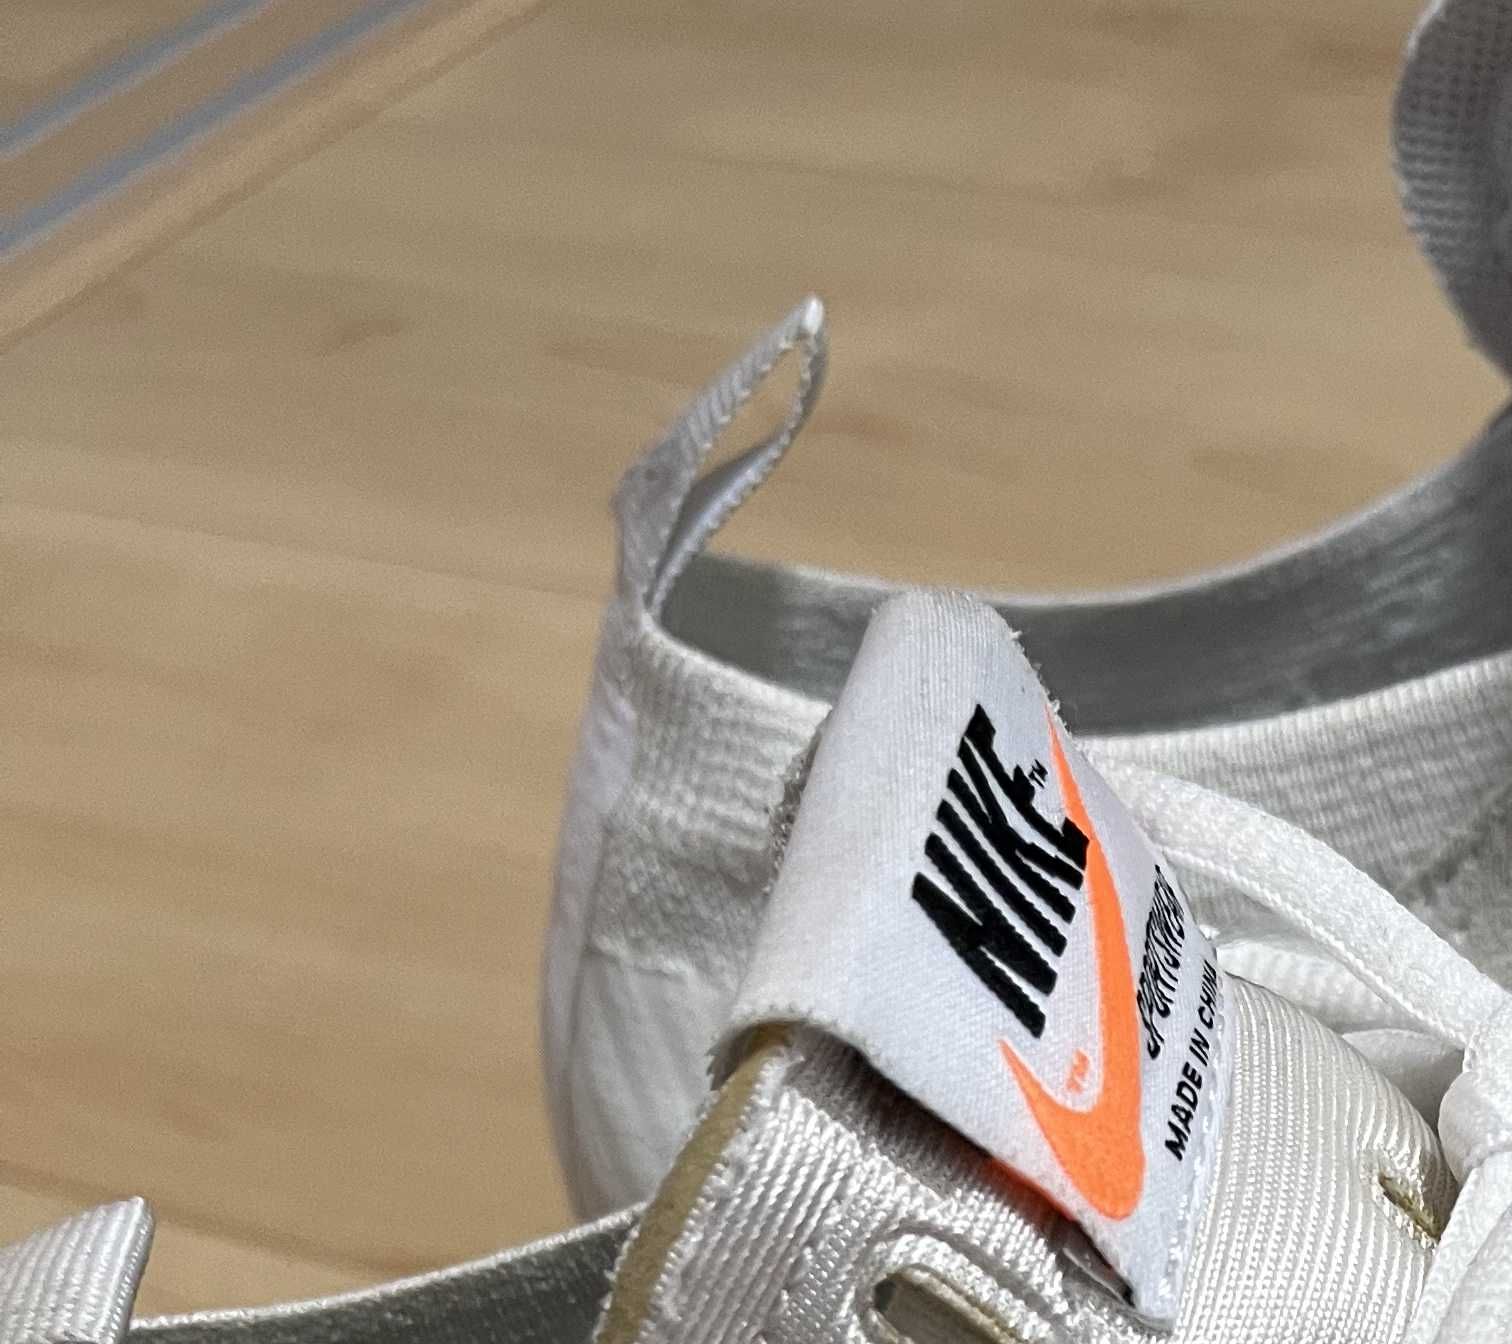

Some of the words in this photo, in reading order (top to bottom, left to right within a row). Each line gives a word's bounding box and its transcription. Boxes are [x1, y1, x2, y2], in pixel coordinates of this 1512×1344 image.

[911, 703, 1090, 1038] NIKE
[1165, 1062, 1203, 1162] MADE
[1189, 1027, 1210, 1067] IN
